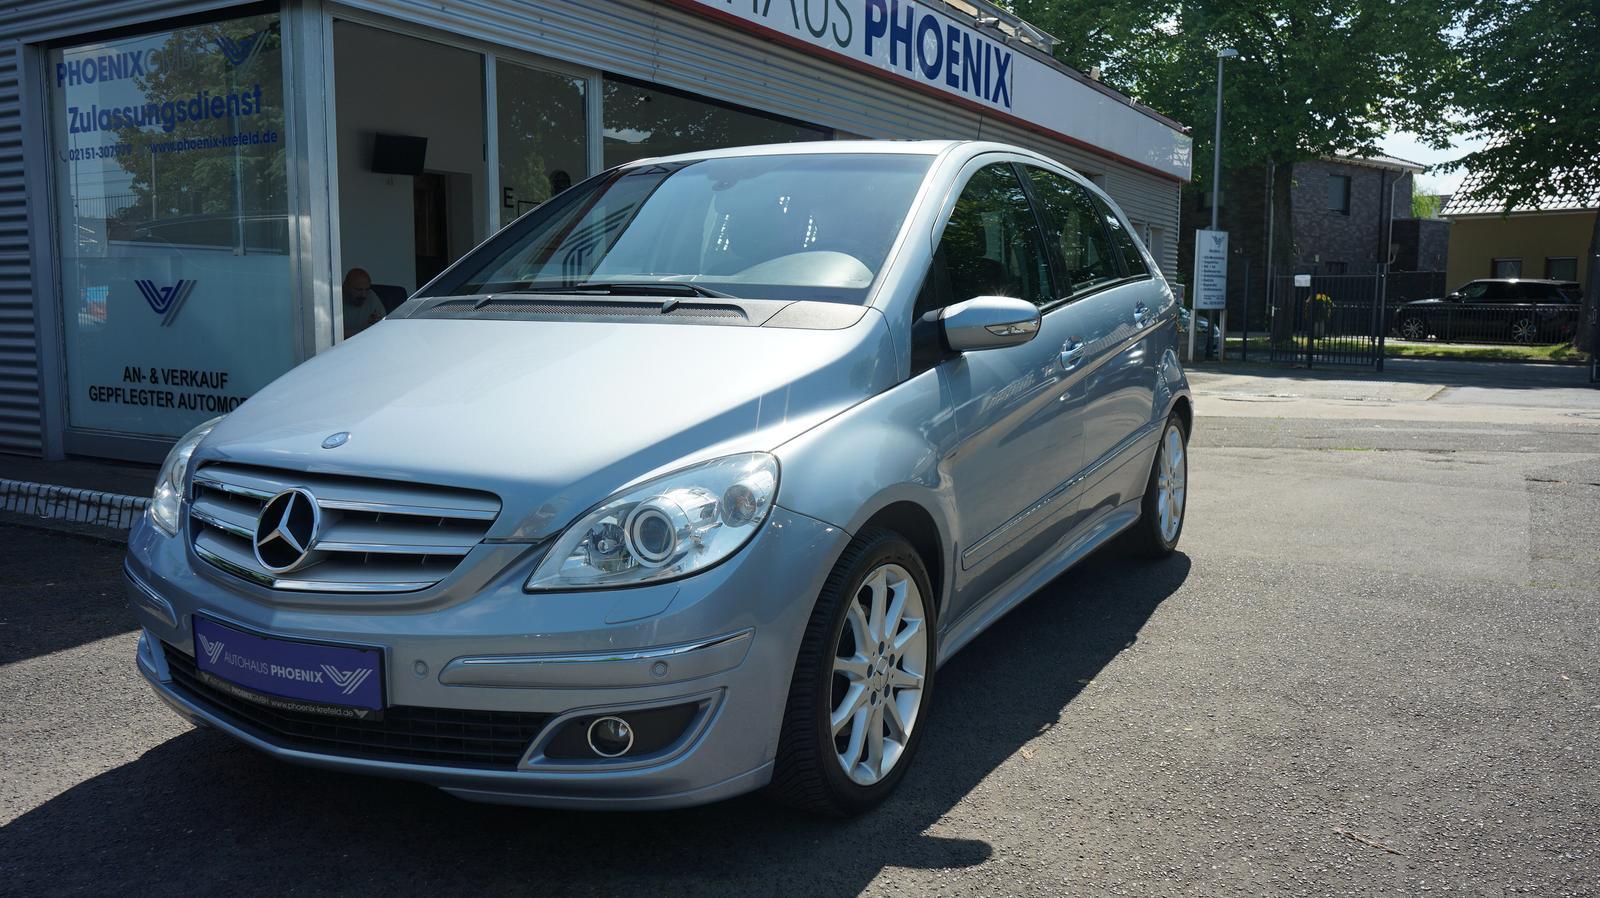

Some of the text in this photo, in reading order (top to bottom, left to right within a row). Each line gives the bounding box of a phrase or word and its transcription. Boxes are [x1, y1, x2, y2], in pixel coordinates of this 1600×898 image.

[865, 0, 1011, 108] PHOENIX
[68, 84, 262, 134] Zulassungsdienst
[151, 131, 278, 155] www.phoenix-krefeld.de
[123, 366, 229, 389] AN- & VERKAUF
[88, 385, 173, 408] GEPFLEGTER
[224, 652, 323, 684] AUTOHAUS PHOENIX
